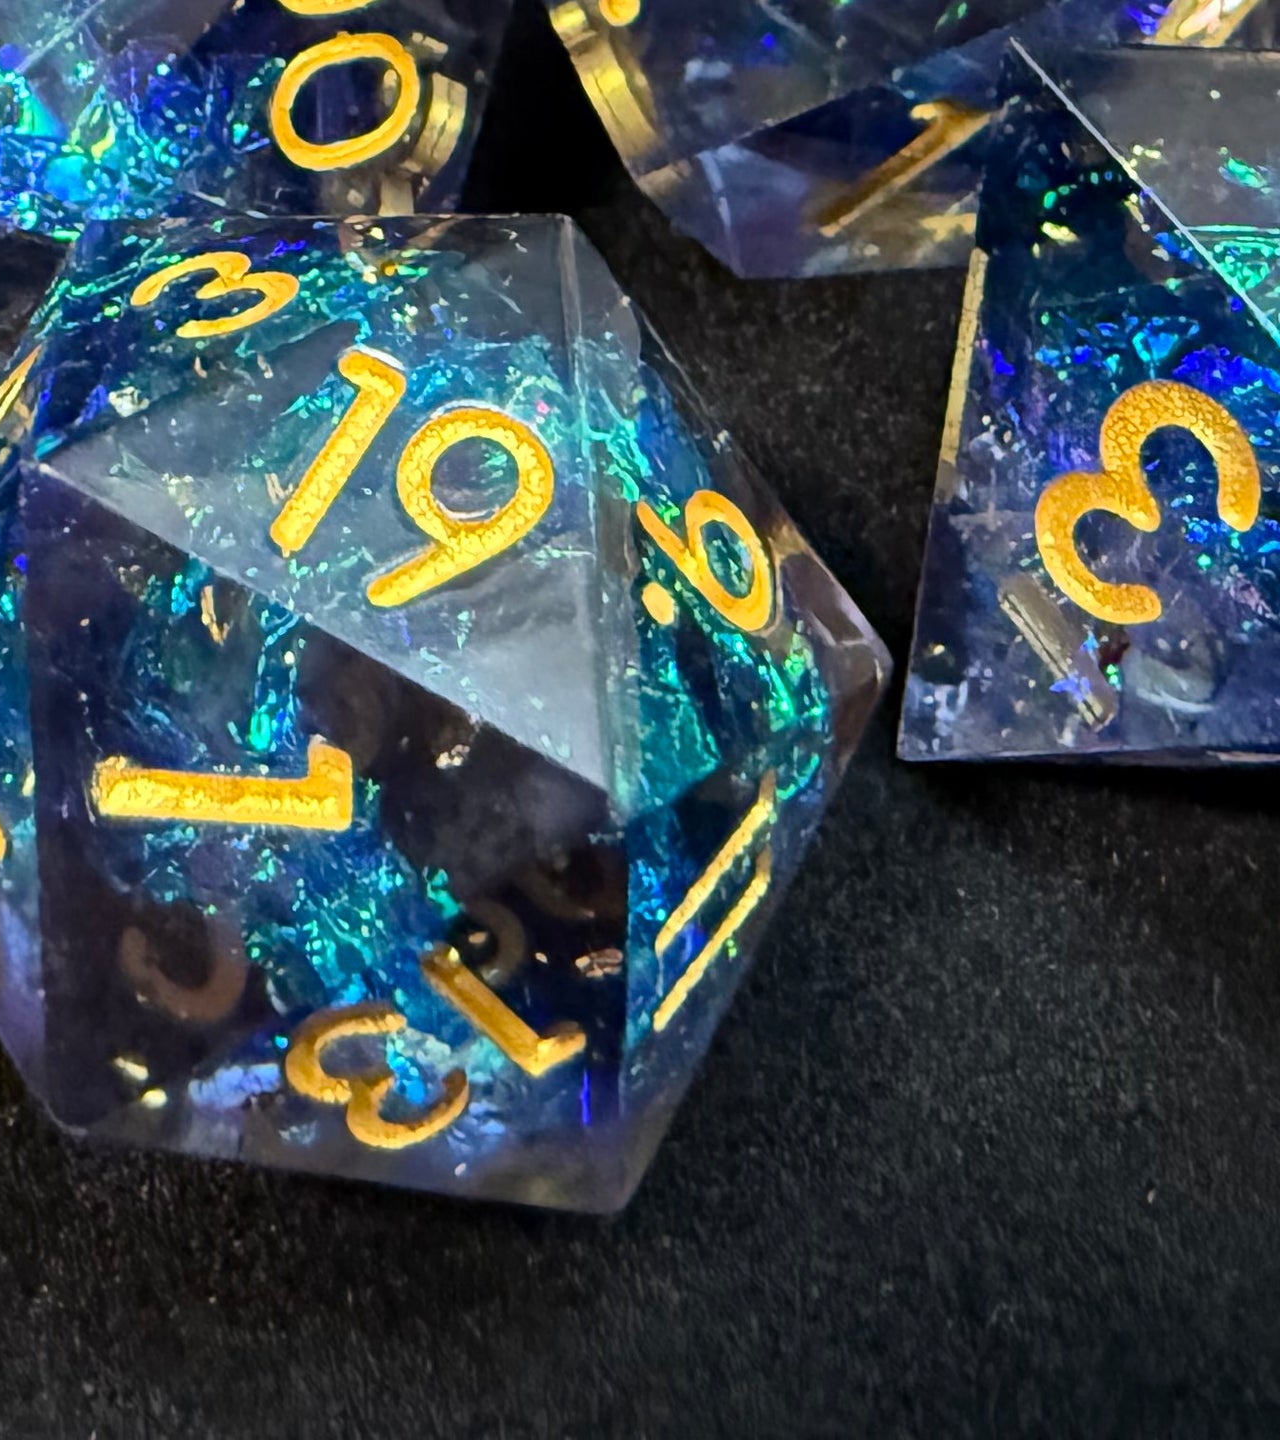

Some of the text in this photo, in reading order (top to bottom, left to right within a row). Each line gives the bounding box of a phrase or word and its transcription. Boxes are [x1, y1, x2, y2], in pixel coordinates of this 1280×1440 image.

[130, 251, 299, 340] 3
[270, 347, 555, 608] 19
[1034, 379, 1261, 625] 3
[94, 738, 353, 831] 1
[285, 945, 587, 1150] 13
